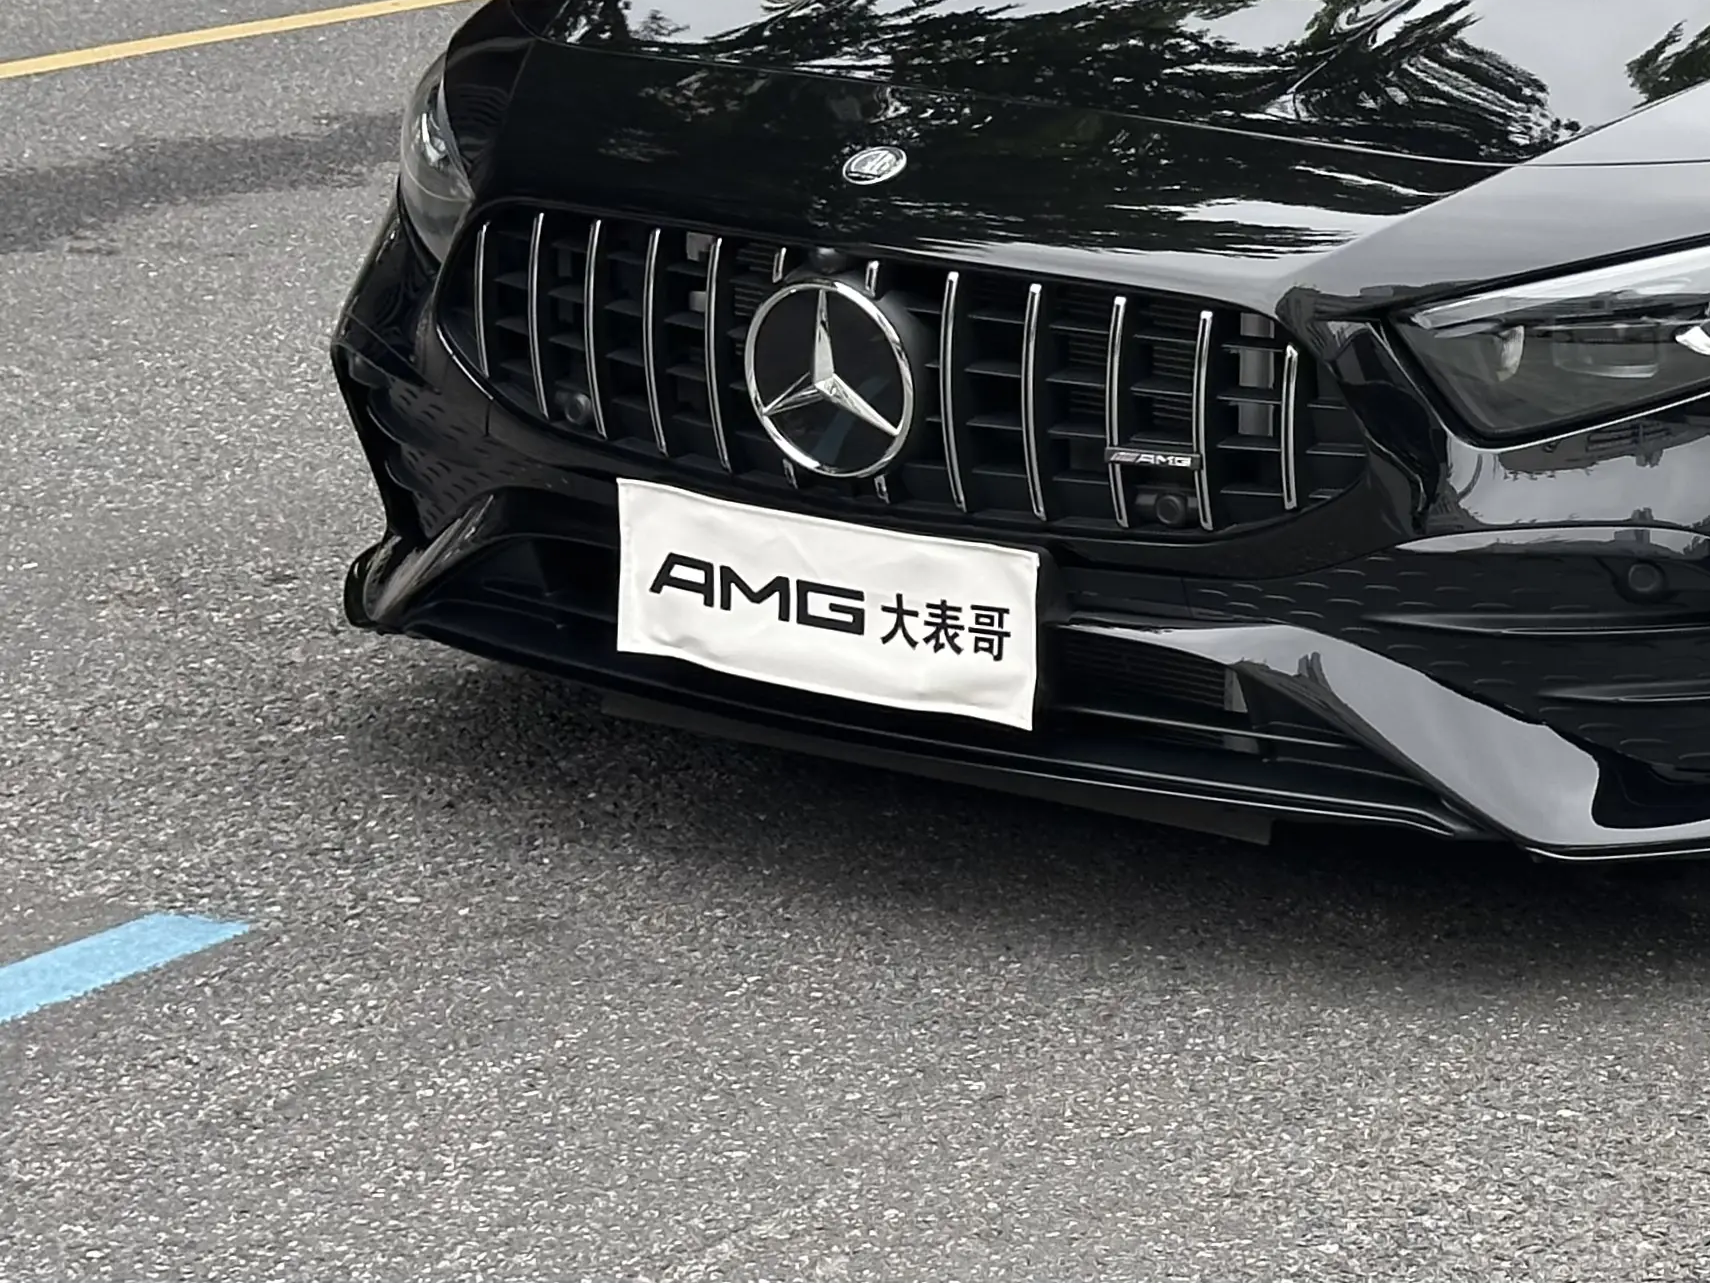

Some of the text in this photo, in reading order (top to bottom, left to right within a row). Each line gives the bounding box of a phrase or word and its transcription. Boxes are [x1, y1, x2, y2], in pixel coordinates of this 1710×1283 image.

[1136, 453, 1192, 467] AMG
[648, 551, 1011, 662] AMG 大表哥
